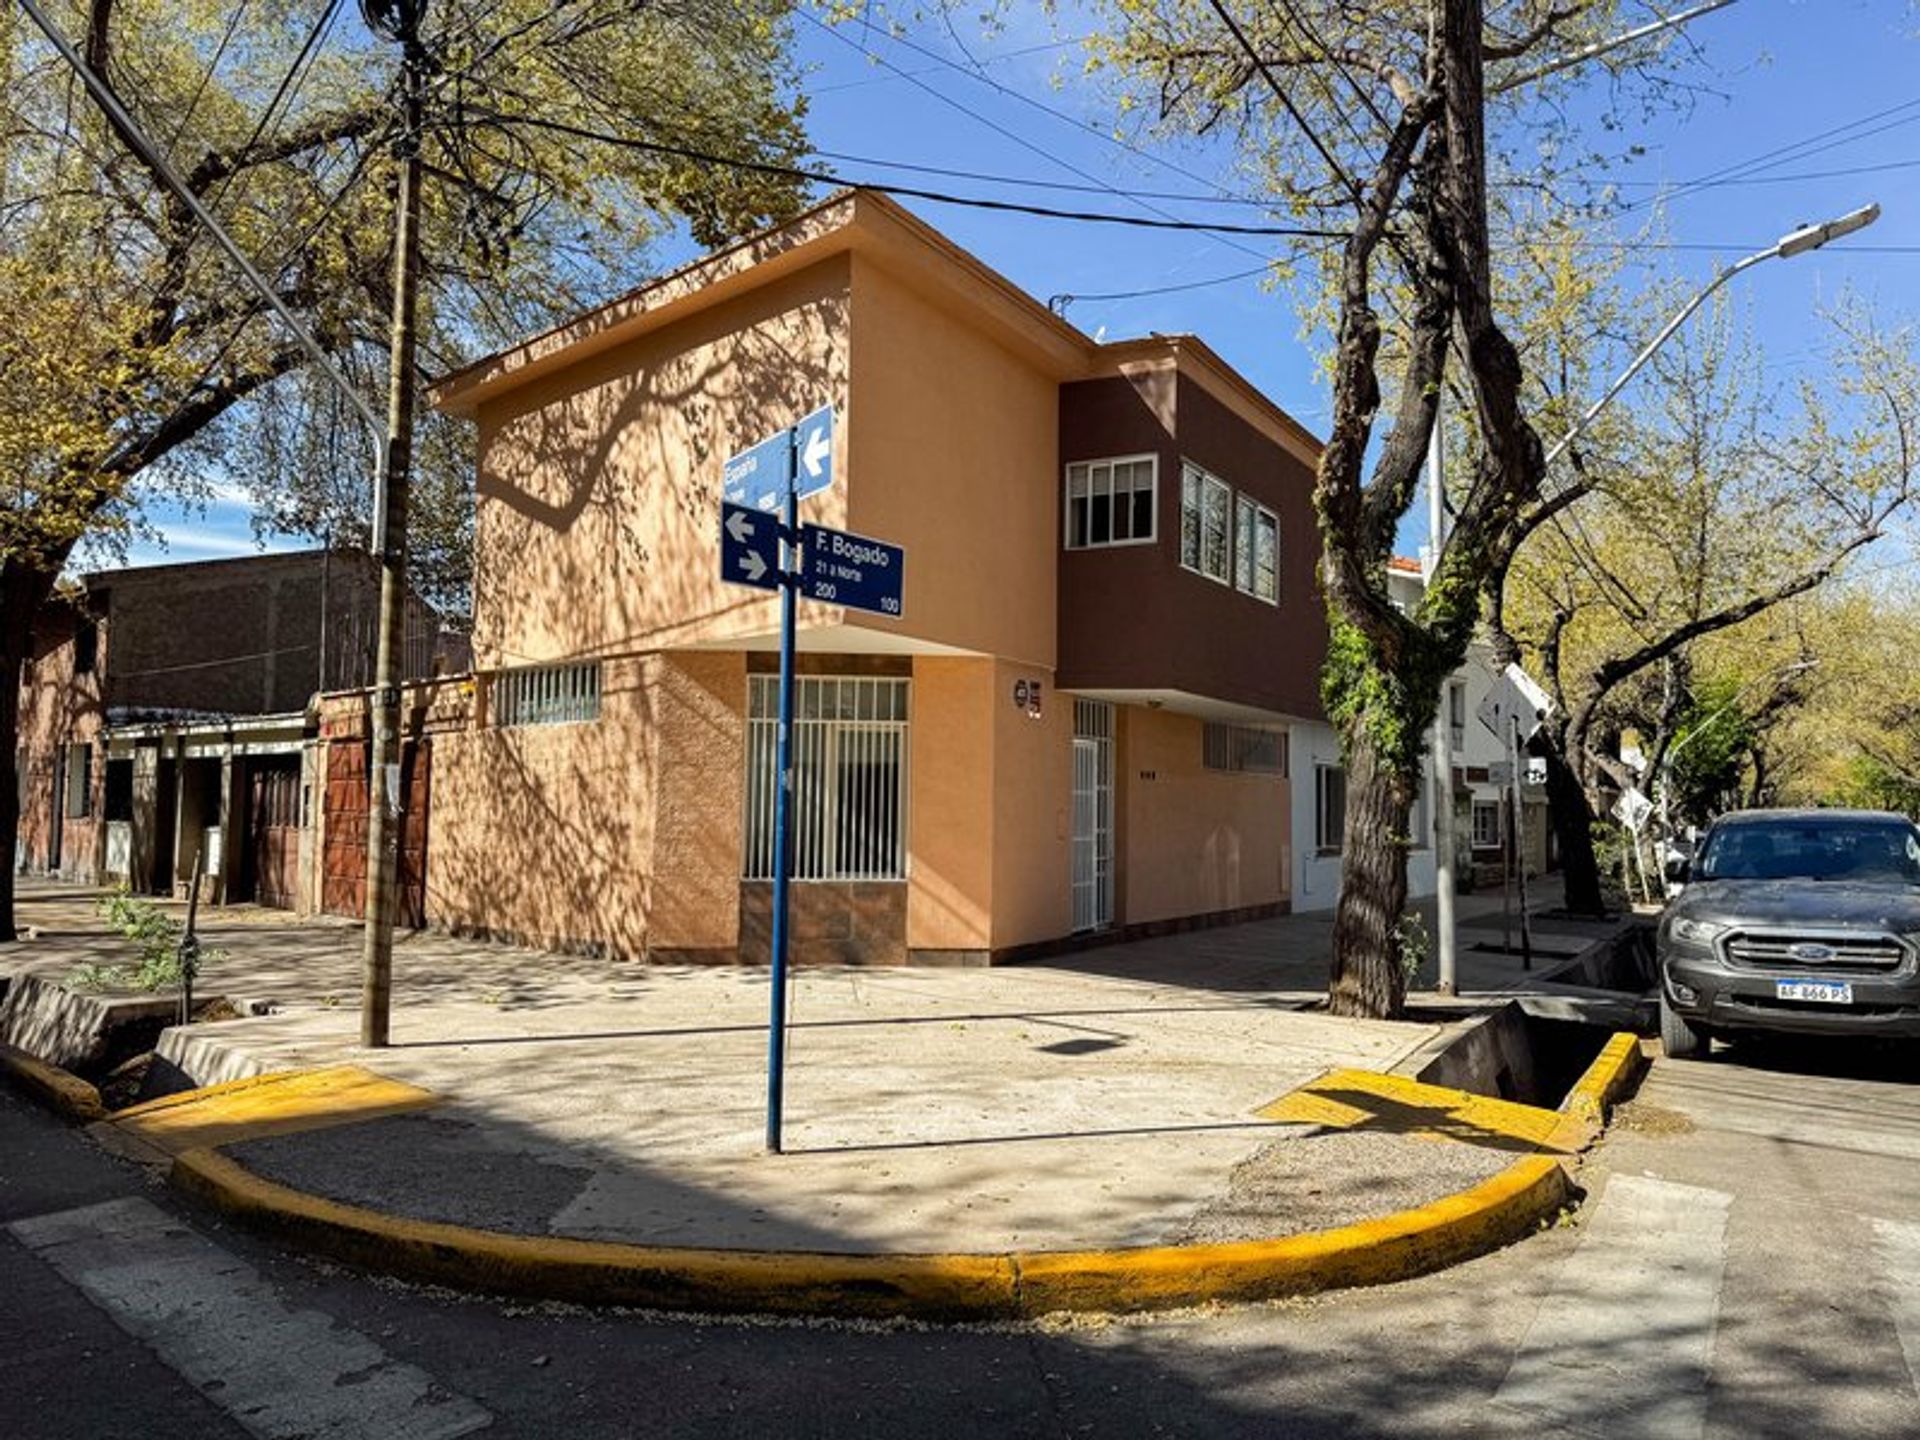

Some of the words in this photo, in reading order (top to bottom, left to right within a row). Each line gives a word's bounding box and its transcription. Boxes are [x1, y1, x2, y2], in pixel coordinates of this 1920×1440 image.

[816, 531, 829, 550] F.
[833, 535, 889, 567] Bogado
[816, 560, 827, 574] 21
[816, 581, 836, 599] 200
[881, 596, 899, 612] 100
